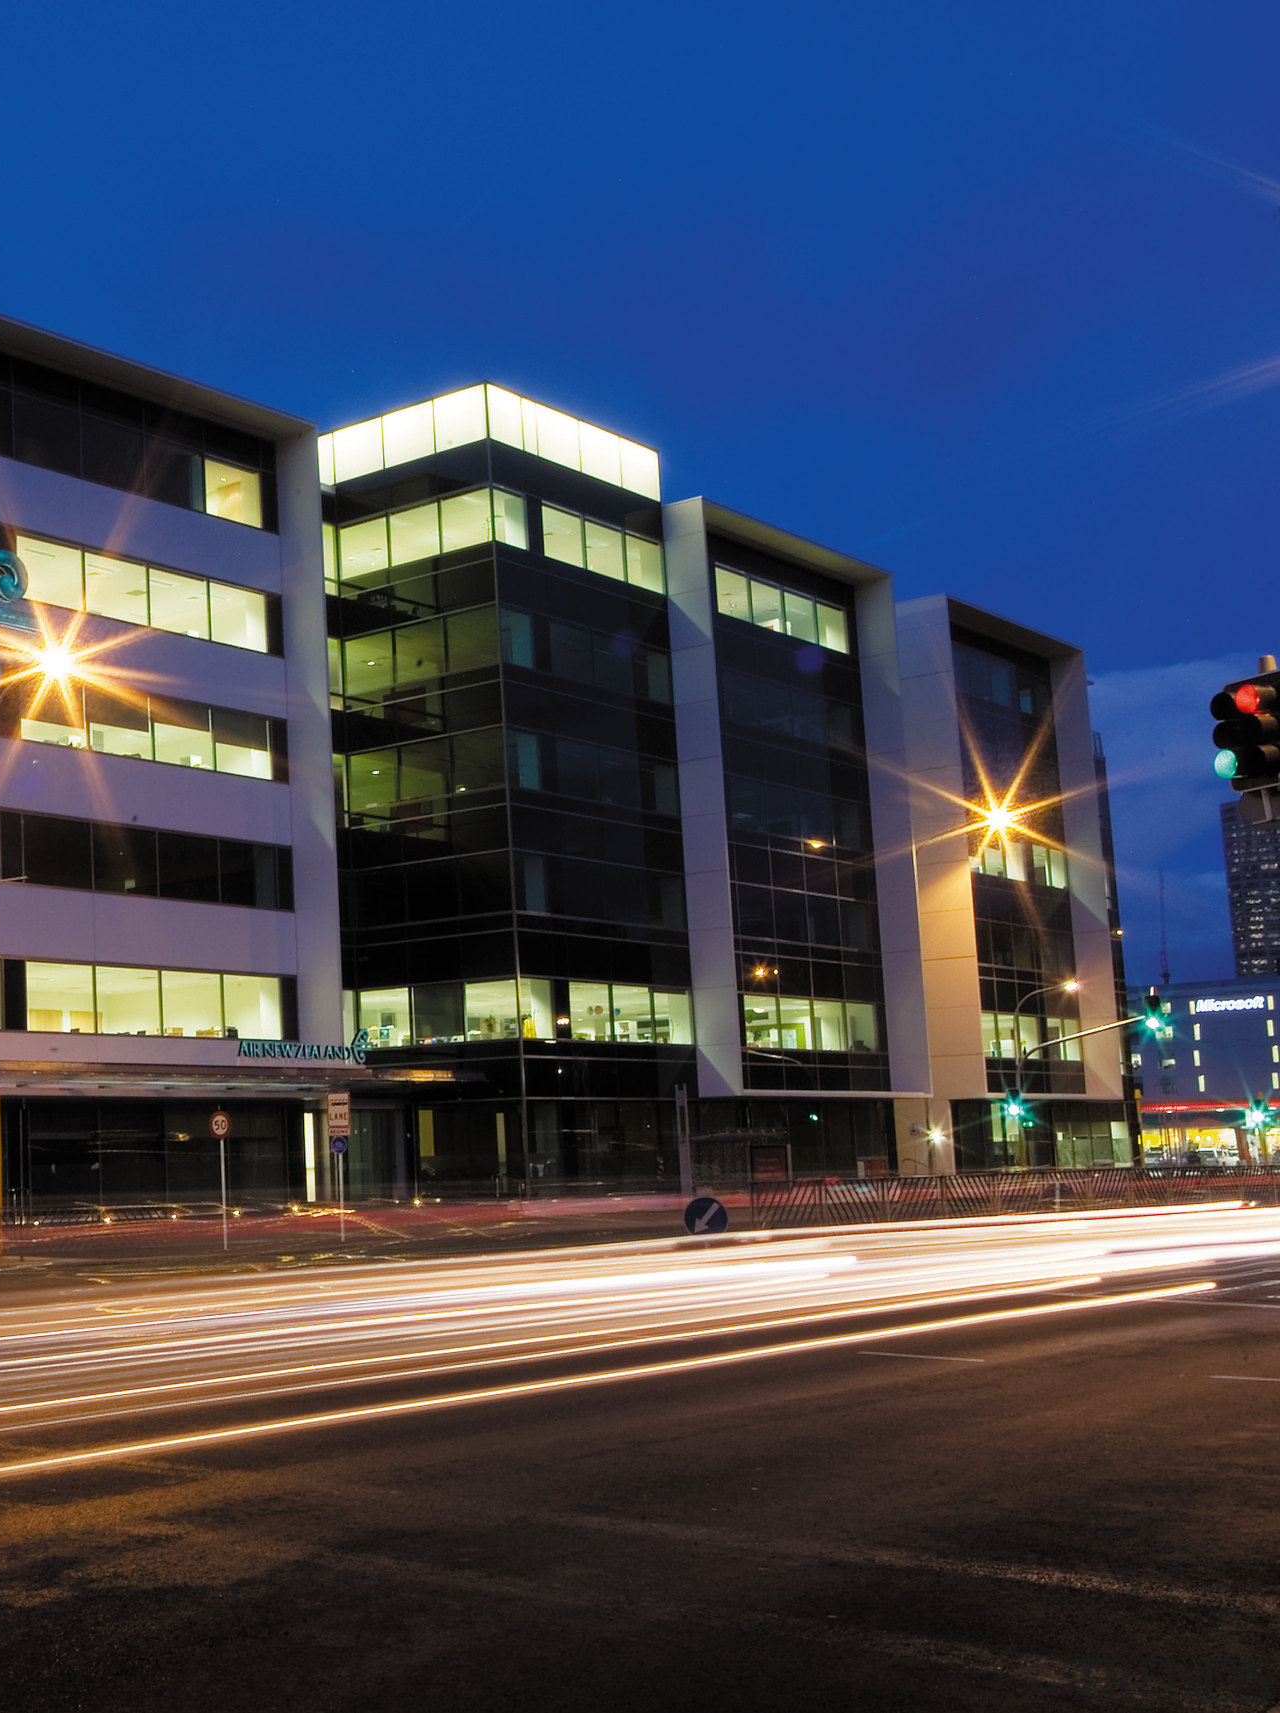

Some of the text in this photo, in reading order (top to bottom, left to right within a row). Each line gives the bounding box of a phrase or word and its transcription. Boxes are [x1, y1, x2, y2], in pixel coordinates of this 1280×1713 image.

[1196, 996, 1265, 1012] Microsoft
[238, 1040, 351, 1060] AIR NEW ZEALAND
[330, 1112, 348, 1121] LANE
[214, 1120, 226, 1131] 50
